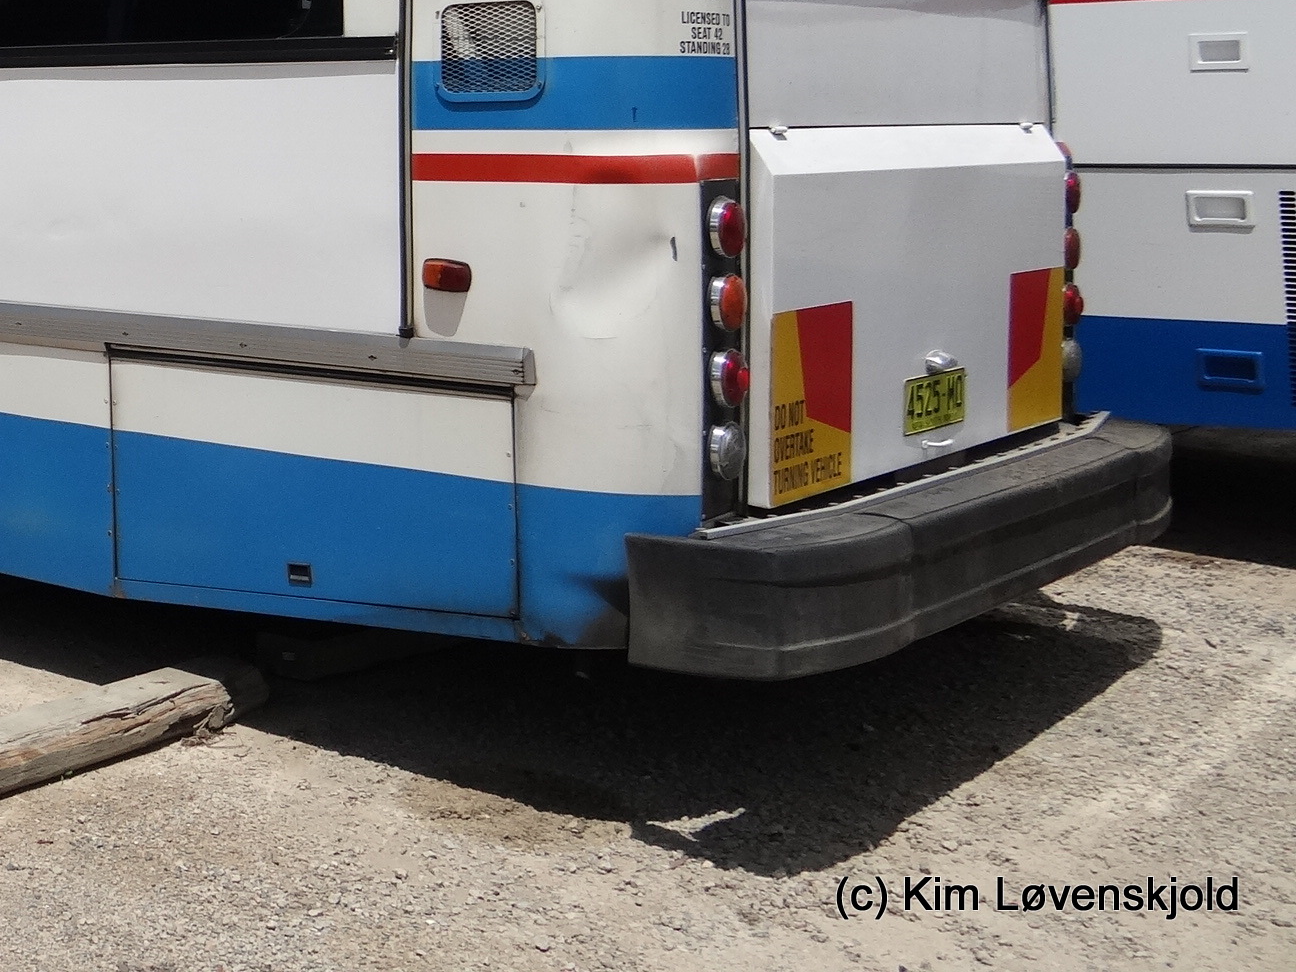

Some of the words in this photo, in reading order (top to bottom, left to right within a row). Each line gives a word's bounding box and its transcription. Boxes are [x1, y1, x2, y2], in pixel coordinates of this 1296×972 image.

[681, 11, 721, 26] LICENSED
[722, 13, 731, 27] TO
[691, 26, 712, 40] SEAT
[714, 28, 723, 40] 42
[679, 40, 722, 55] STANDING
[774, 403, 786, 431] DO
[788, 399, 805, 428] NOT
[773, 428, 814, 464] OVERTAKE
[773, 461, 809, 496] TURNING
[810, 451, 842, 484] VEHICLE
